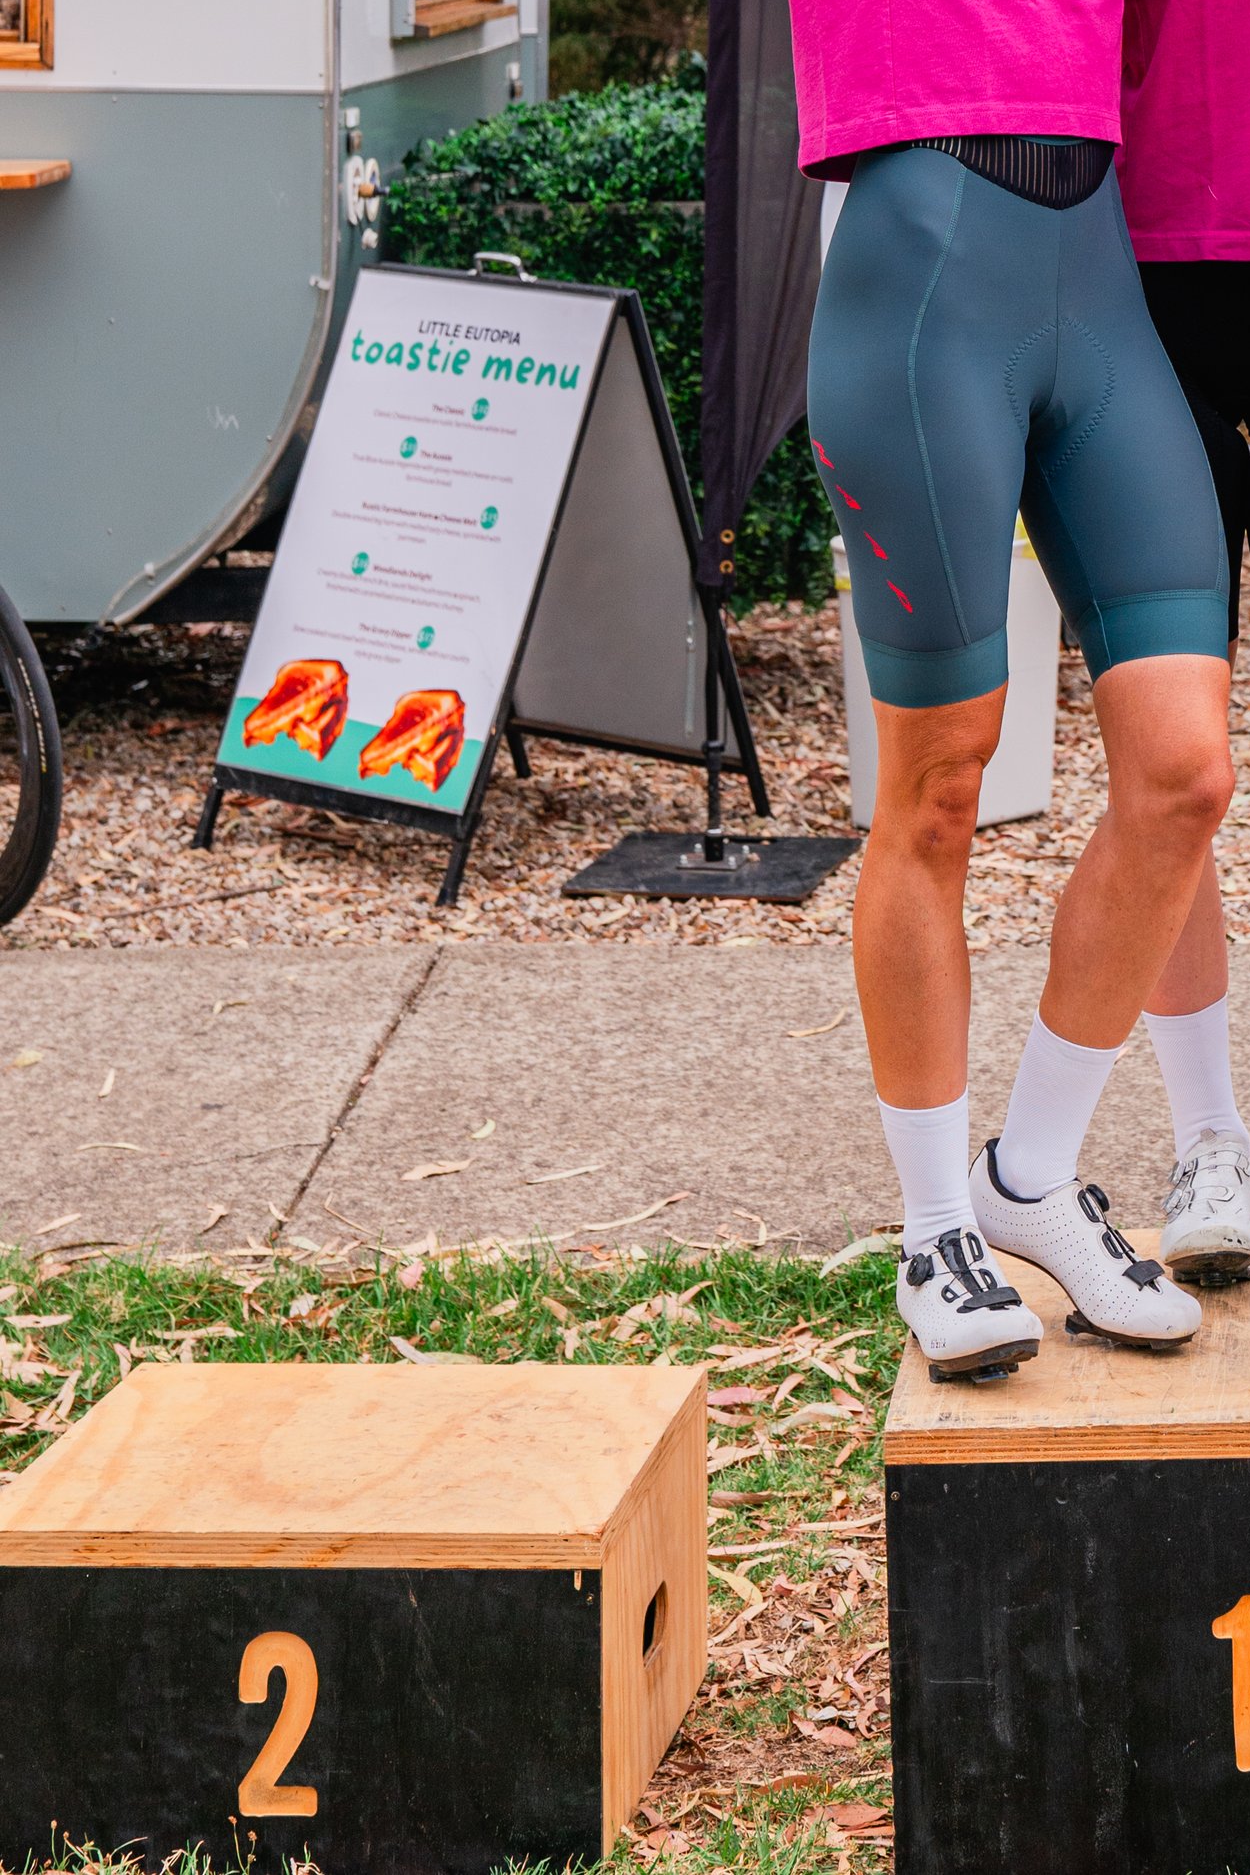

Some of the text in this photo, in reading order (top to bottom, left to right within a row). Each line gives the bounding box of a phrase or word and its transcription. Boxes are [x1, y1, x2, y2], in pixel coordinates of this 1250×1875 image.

[351, 329, 581, 390] toastie menu
[418, 320, 521, 345] LITTLE EUTOPIA
[238, 1630, 318, 1817] 2
